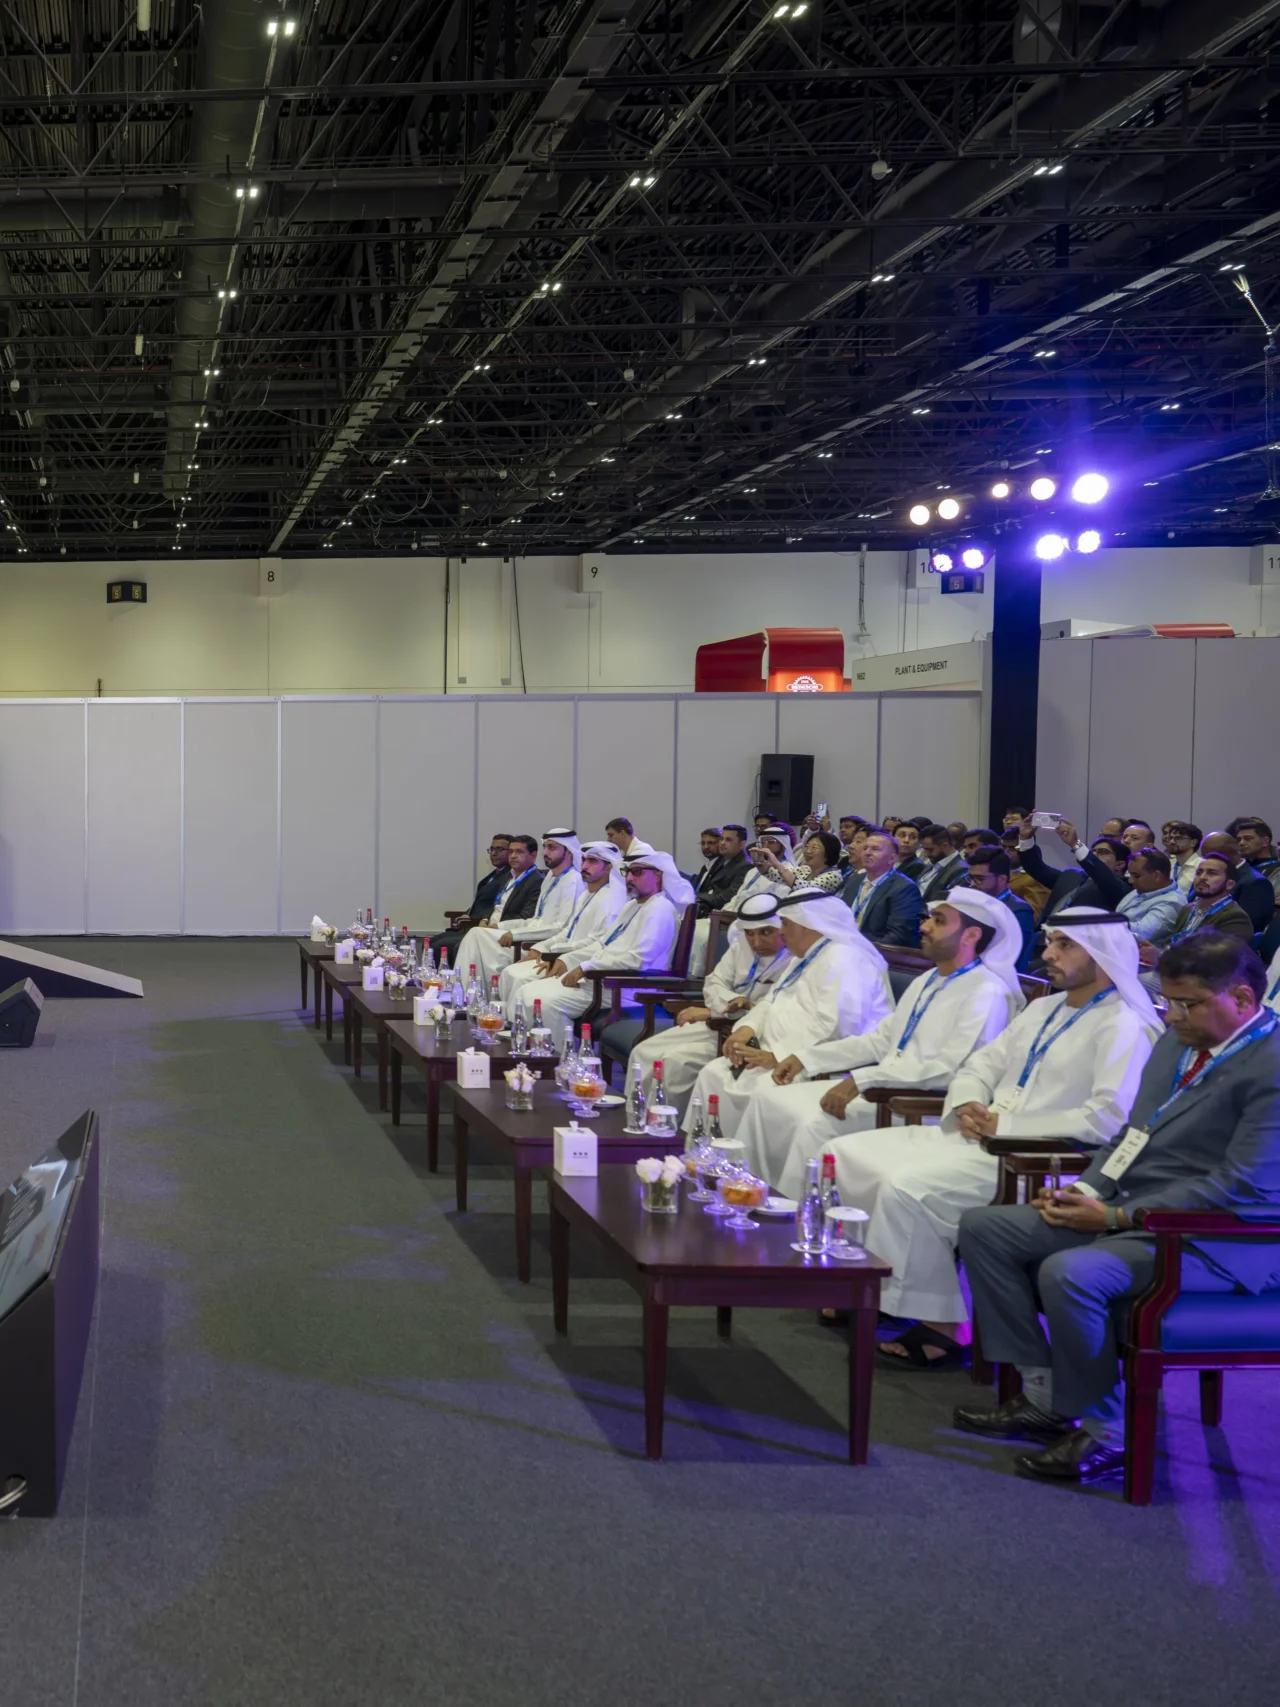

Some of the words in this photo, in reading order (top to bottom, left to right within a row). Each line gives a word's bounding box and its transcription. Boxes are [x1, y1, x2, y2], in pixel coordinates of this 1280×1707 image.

[267, 570, 275, 582] 8
[591, 566, 598, 578] 9
[895, 665, 912, 675] PLANT
[912, 665, 917, 673] &
[917, 661, 948, 673] EQUIPMENT
